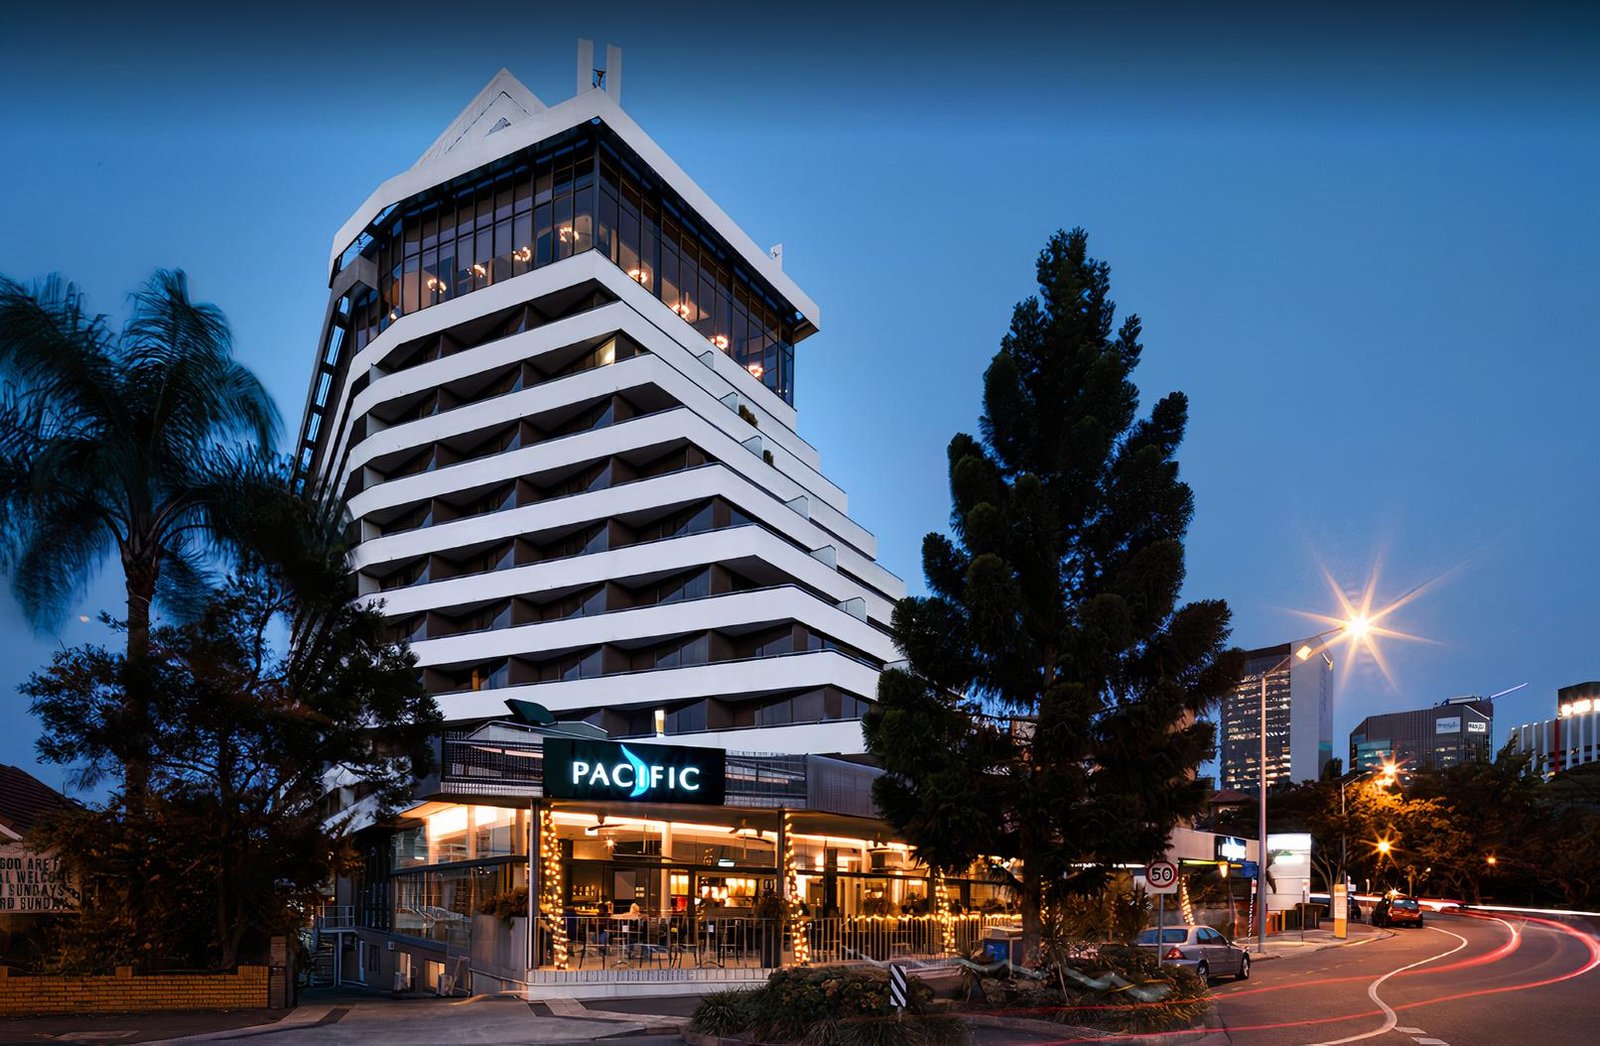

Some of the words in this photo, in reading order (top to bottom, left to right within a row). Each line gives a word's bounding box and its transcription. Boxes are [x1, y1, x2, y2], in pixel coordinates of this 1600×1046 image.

[572, 761, 700, 791] PACIFIC
[0, 857, 21, 869] GOD
[1152, 867, 1173, 881] 50
[9, 884, 64, 897] SUNDAYS
